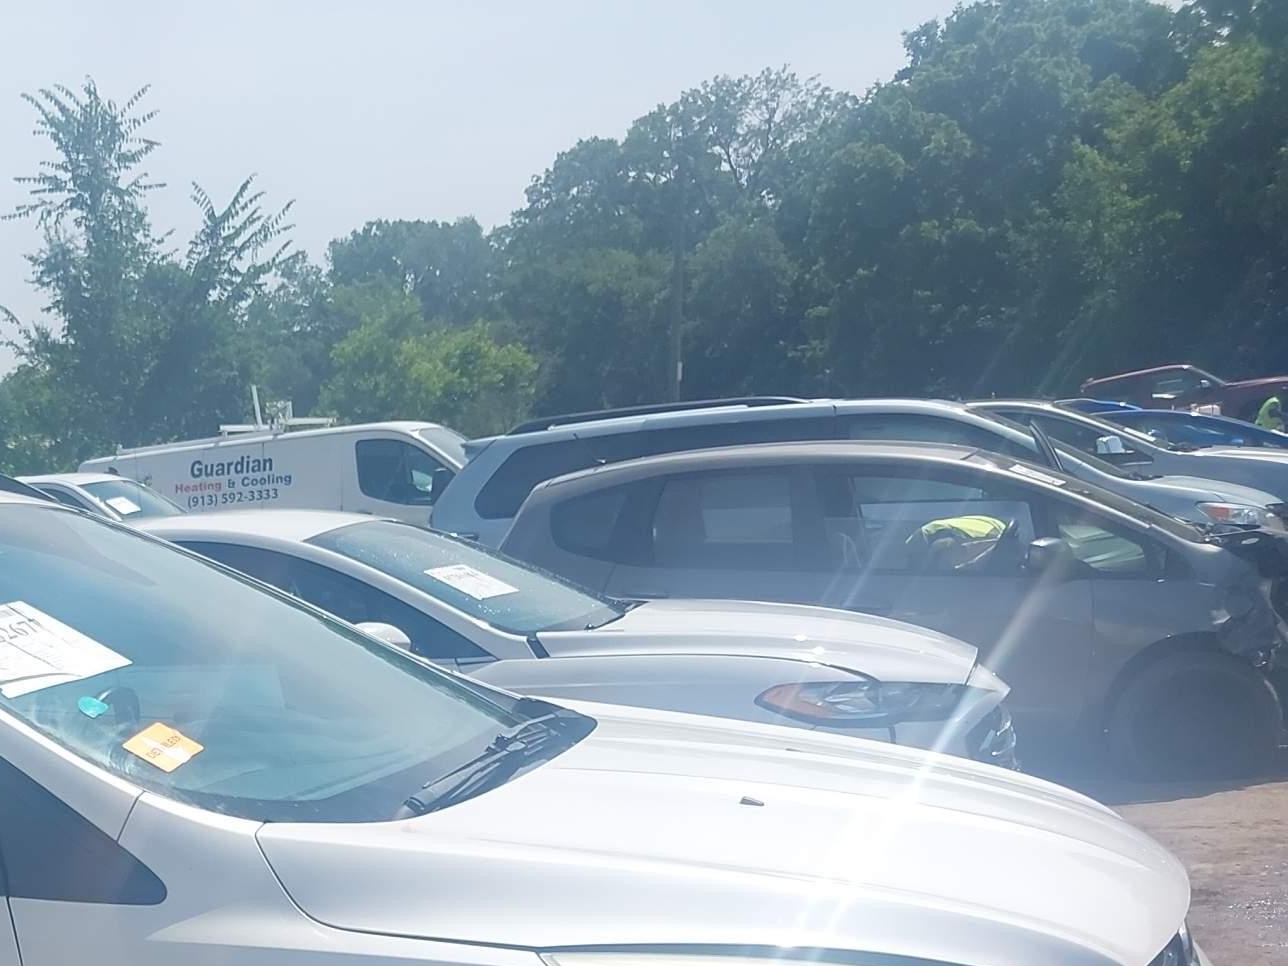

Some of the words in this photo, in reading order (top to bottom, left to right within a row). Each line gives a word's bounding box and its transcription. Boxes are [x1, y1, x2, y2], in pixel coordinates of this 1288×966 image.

[190, 455, 273, 479] Guardian
[174, 481, 222, 494] Heating
[227, 479, 236, 489] &
[241, 473, 292, 486] Cooling
[187, 494, 218, 509] (913)
[221, 488, 279, 504] 592-3333
